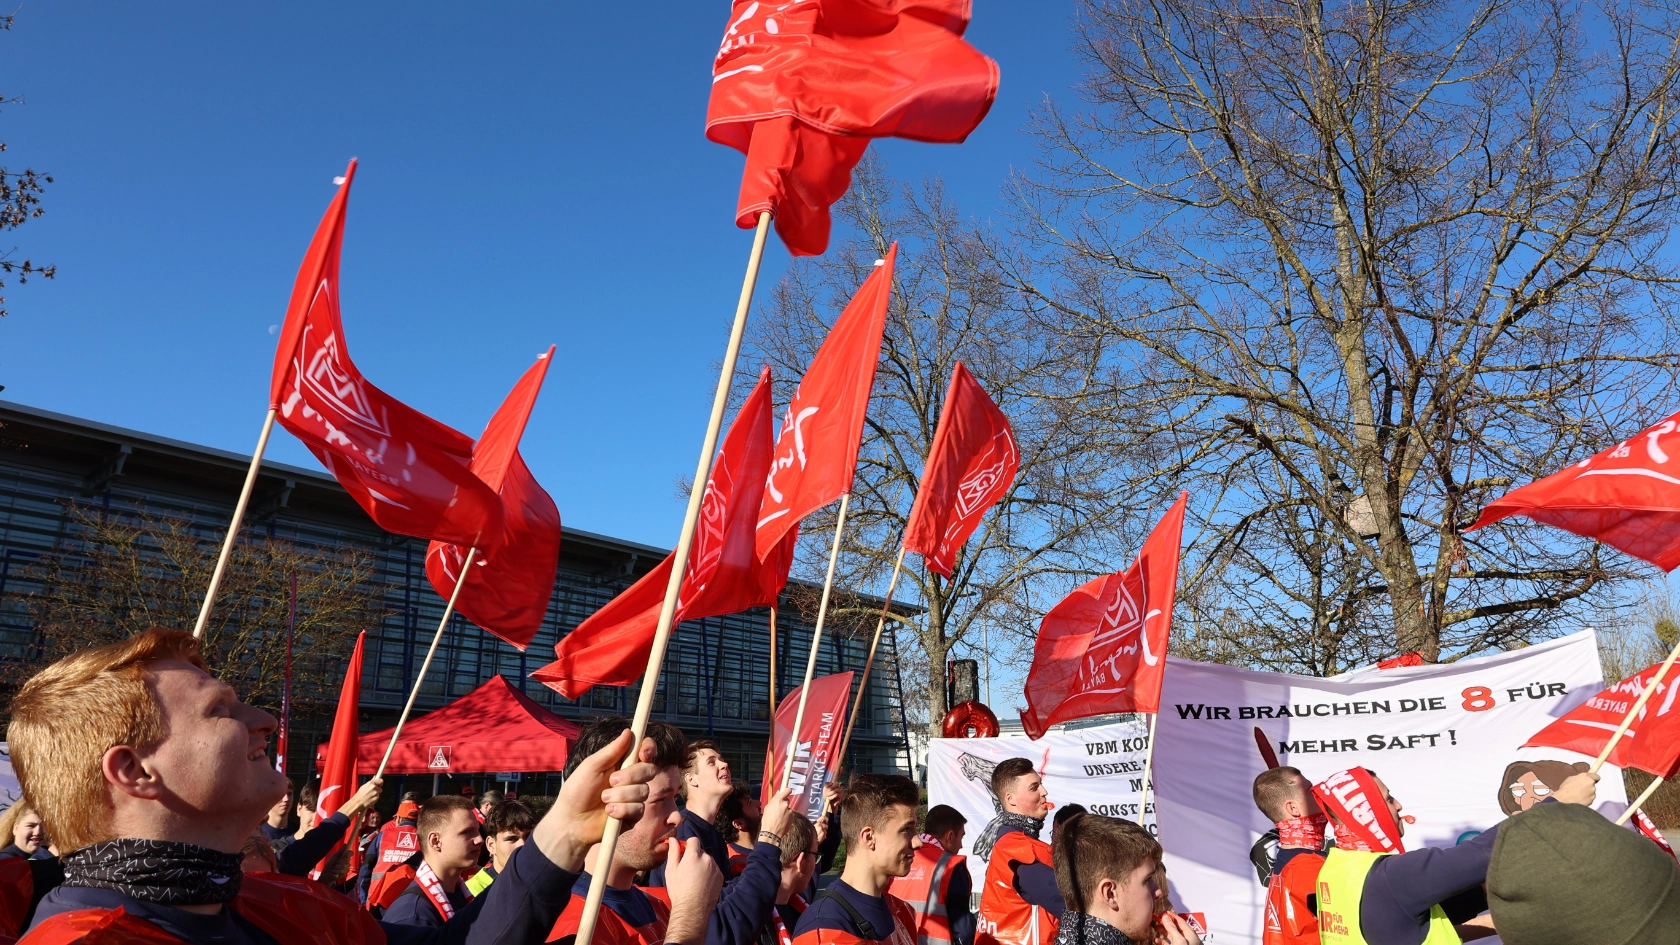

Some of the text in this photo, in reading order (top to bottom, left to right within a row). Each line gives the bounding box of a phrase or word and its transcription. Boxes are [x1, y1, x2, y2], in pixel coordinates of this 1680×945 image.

[1238, 700, 1392, 720] BRAUCHEN
[1399, 696, 1447, 713] DIE
[1460, 686, 1496, 712] 8
[1507, 682, 1568, 702] FÜR
[818, 712, 834, 746] TEAM
[1085, 740, 1118, 756] VBM
[1279, 738, 1360, 755] MEHR
[809, 749, 828, 805] STARKES
[1083, 760, 1142, 777] UNSERE
[1319, 910, 1334, 934] IR
[1333, 911, 1344, 924] FÜR
[1333, 924, 1350, 937] MEHR
